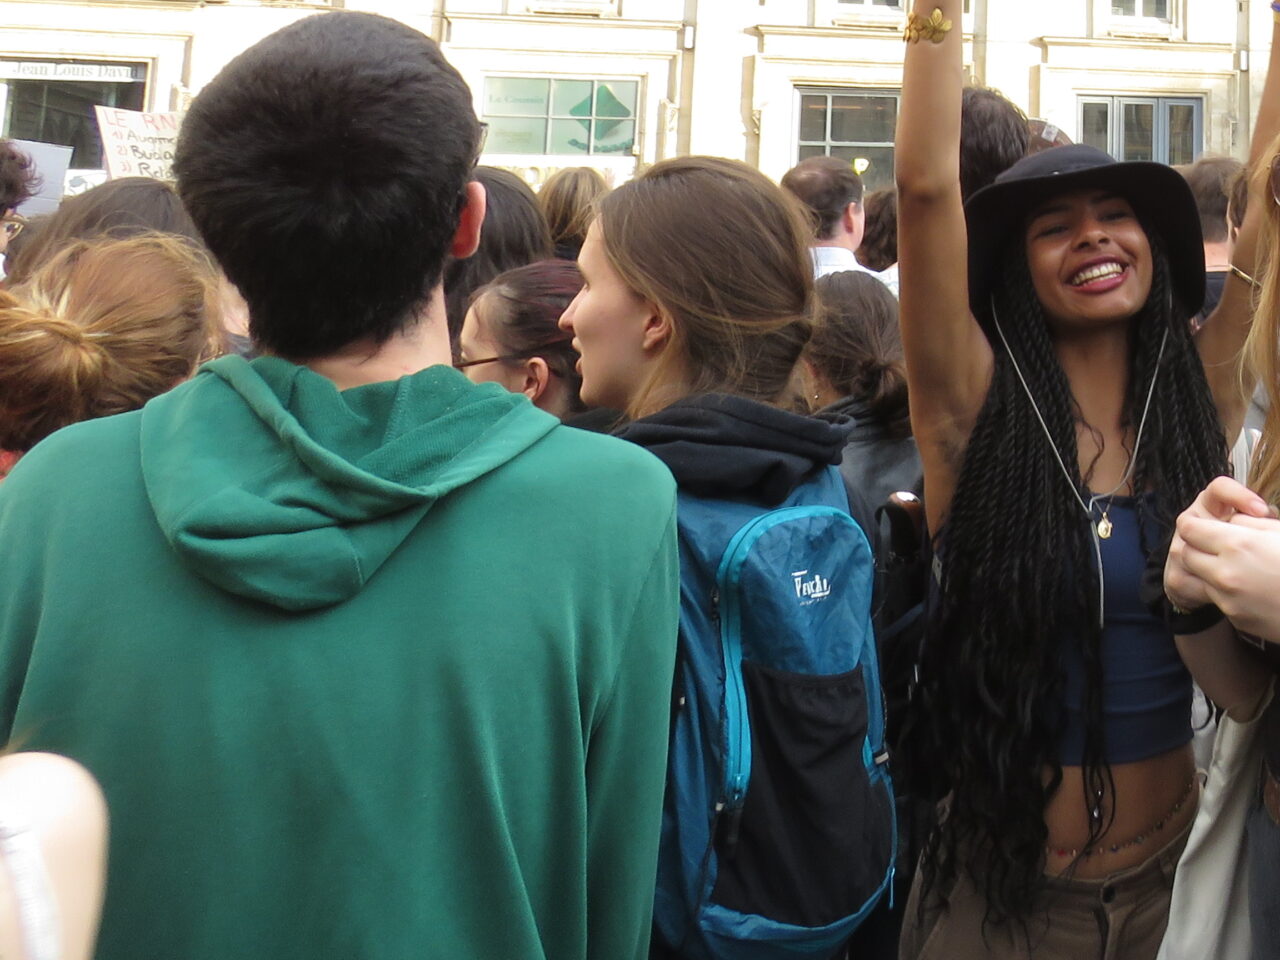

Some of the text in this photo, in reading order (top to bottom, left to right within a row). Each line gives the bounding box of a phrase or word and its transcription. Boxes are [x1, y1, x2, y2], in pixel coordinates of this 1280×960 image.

[12, 62, 138, 79] Jean Louis David
[103, 109, 177, 131] LE RN
